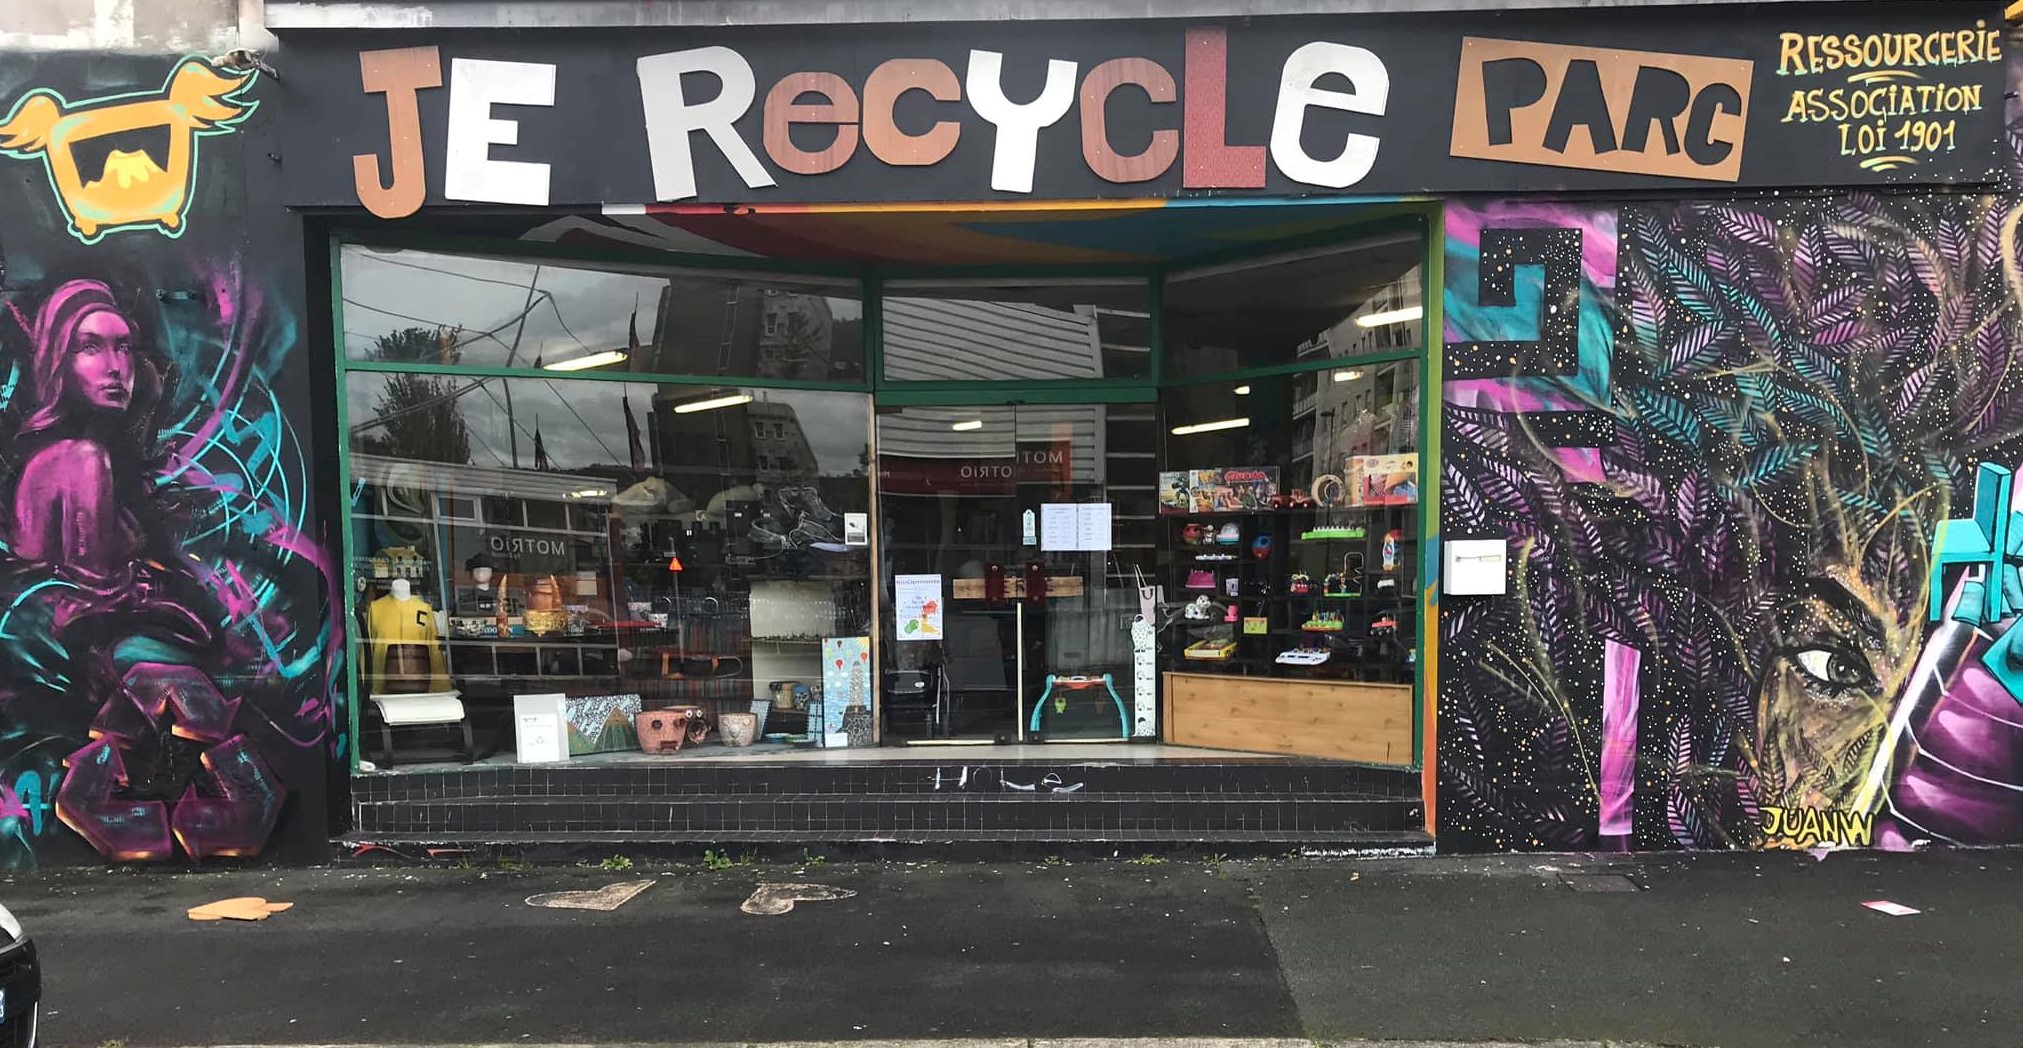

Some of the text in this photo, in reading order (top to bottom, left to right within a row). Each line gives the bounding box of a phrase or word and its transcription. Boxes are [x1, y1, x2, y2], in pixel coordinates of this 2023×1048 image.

[353, 45, 556, 219] JE
[1482, 57, 1742, 166] PARC
[1894, 119, 1957, 152] 1901
[1759, 805, 1874, 846] JUANW
